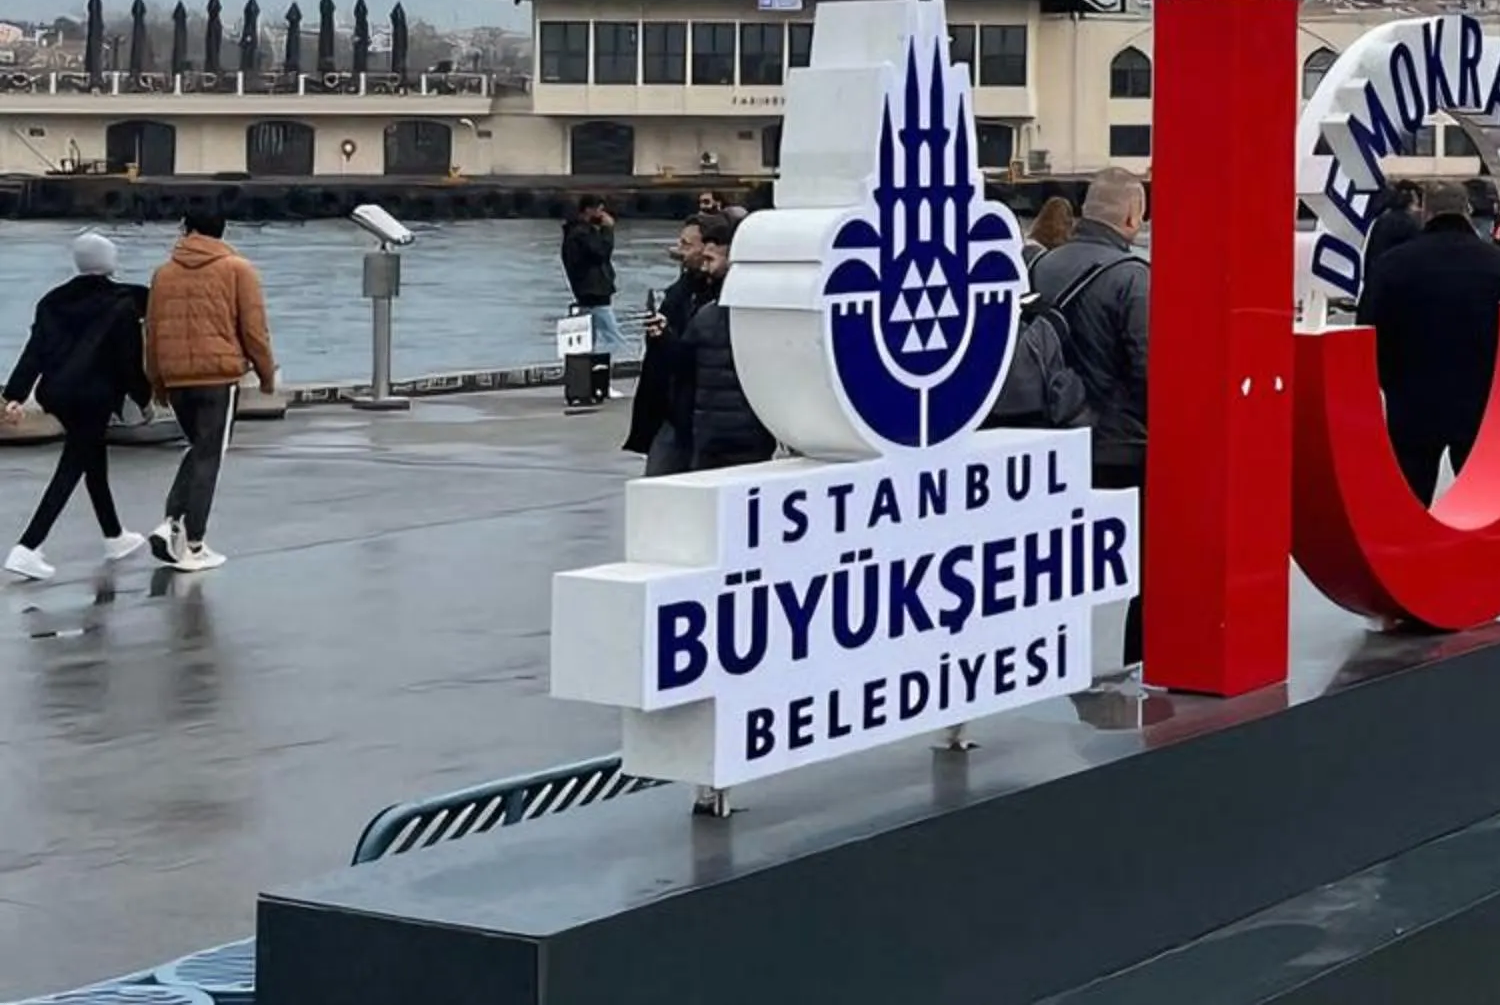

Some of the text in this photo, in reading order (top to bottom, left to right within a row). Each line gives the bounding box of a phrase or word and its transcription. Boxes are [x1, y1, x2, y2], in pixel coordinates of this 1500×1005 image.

[746, 450, 1068, 548] İSTANBUL
[656, 507, 1129, 692] BÜYÜKŞEHİR
[745, 624, 1068, 761] BELEDİYESİ
